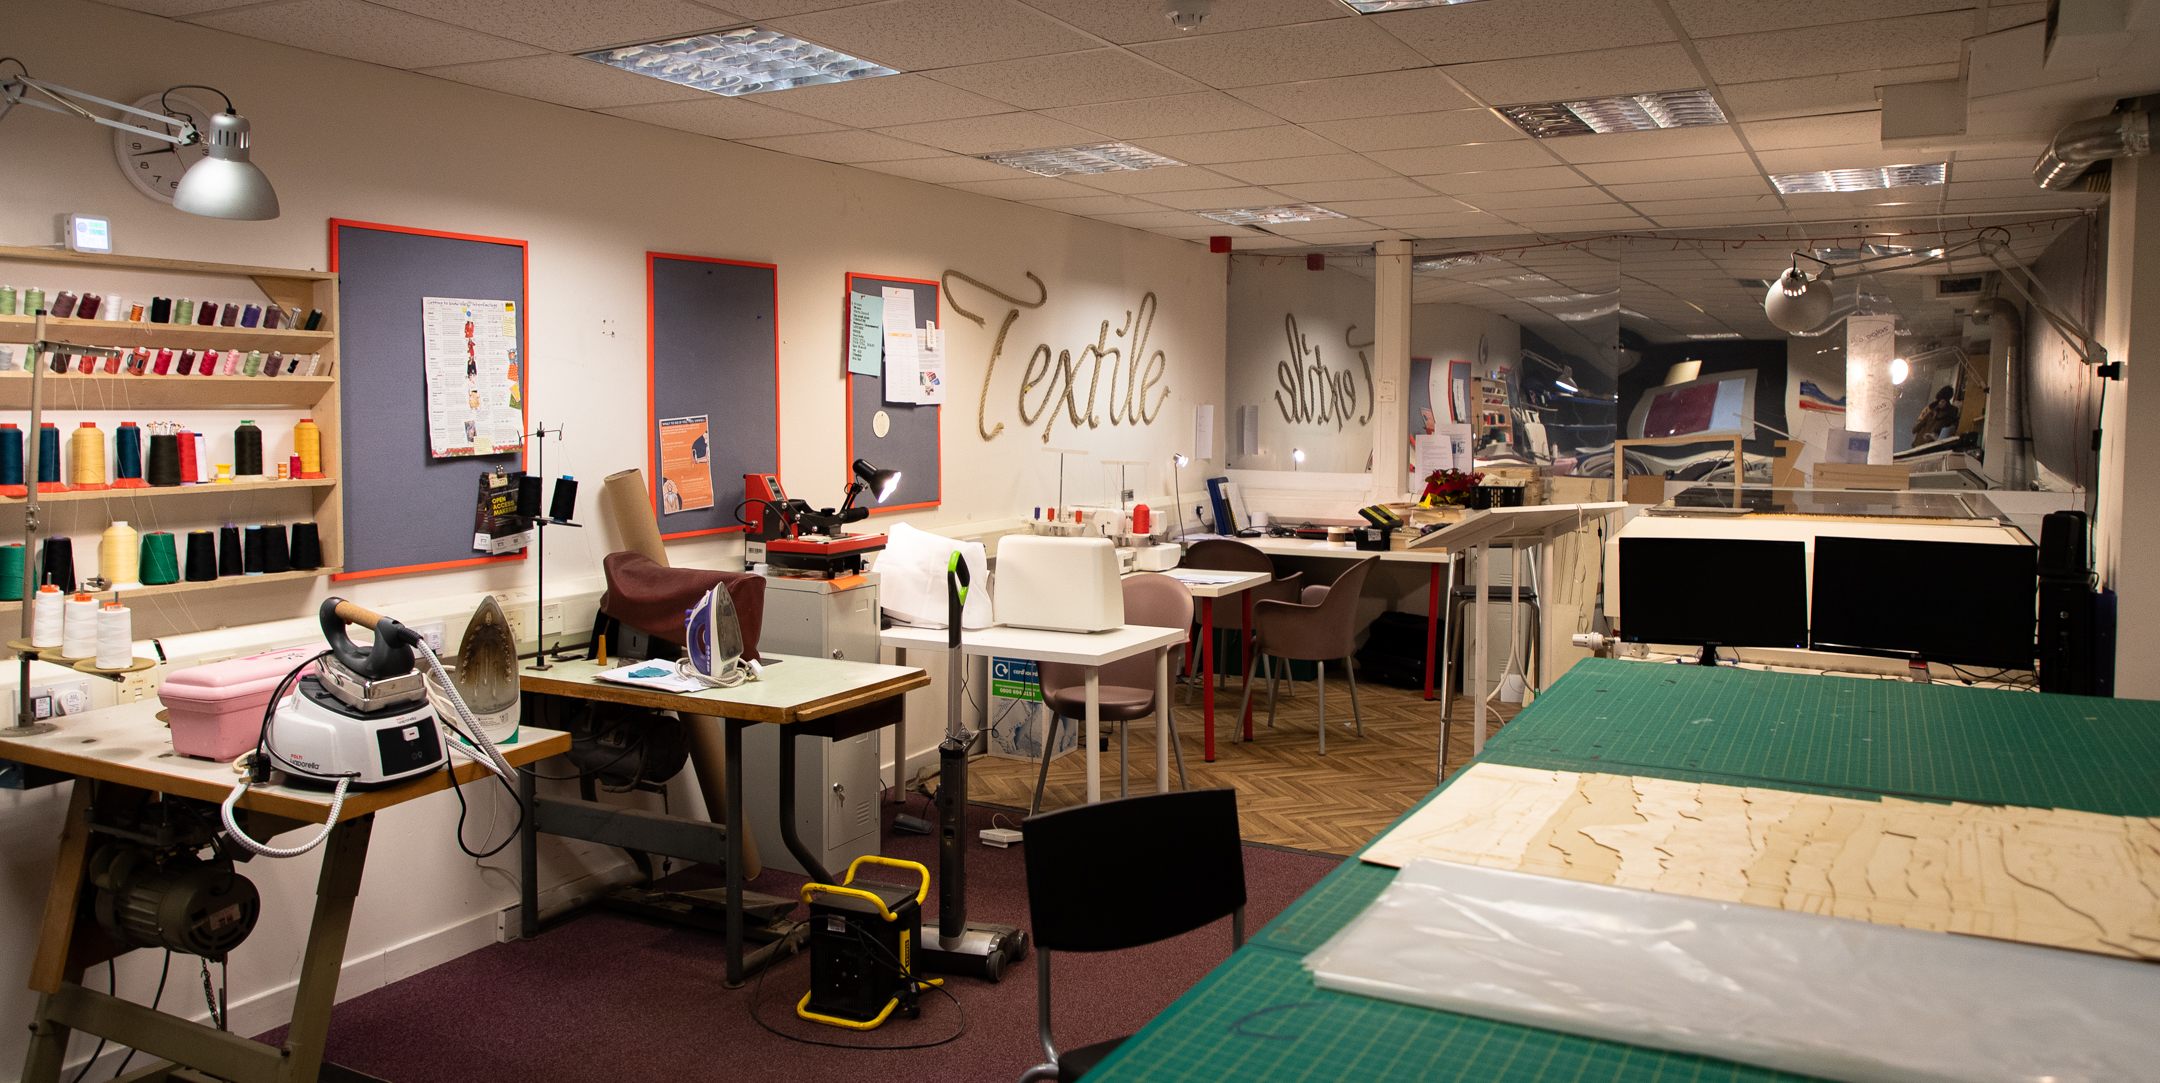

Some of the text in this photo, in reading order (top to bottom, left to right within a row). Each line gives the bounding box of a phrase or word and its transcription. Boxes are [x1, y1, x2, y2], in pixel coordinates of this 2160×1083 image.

[132, 142, 141, 150] 9
[140, 161, 149, 169] 8
[152, 174, 162, 182] 7
[942, 269, 1170, 443] Textile
[492, 496, 506, 504] OPEN
[493, 500, 514, 510] ACCESS
